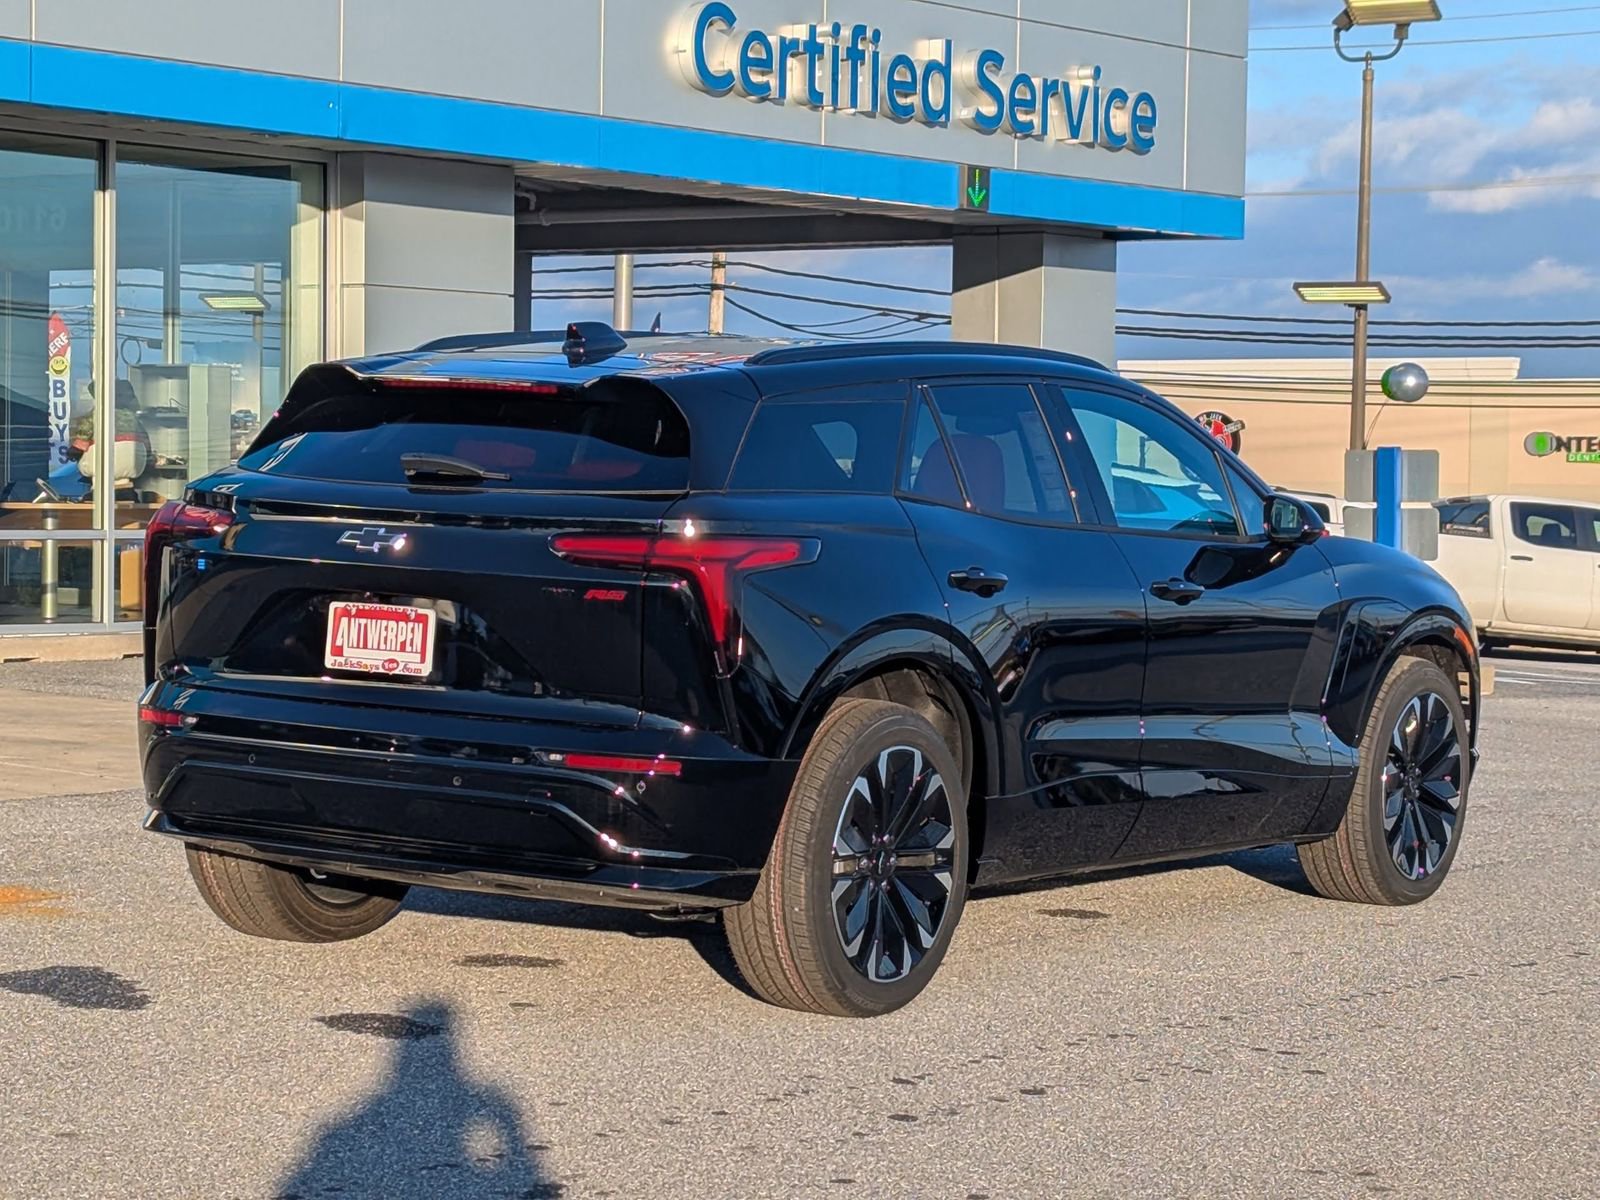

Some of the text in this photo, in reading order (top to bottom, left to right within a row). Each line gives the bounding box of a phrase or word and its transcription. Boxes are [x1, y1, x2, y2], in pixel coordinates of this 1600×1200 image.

[690, 1, 1158, 150] Certified Service
[51, 379, 68, 465] BUYS
[335, 616, 423, 653] ANTWERPEN
